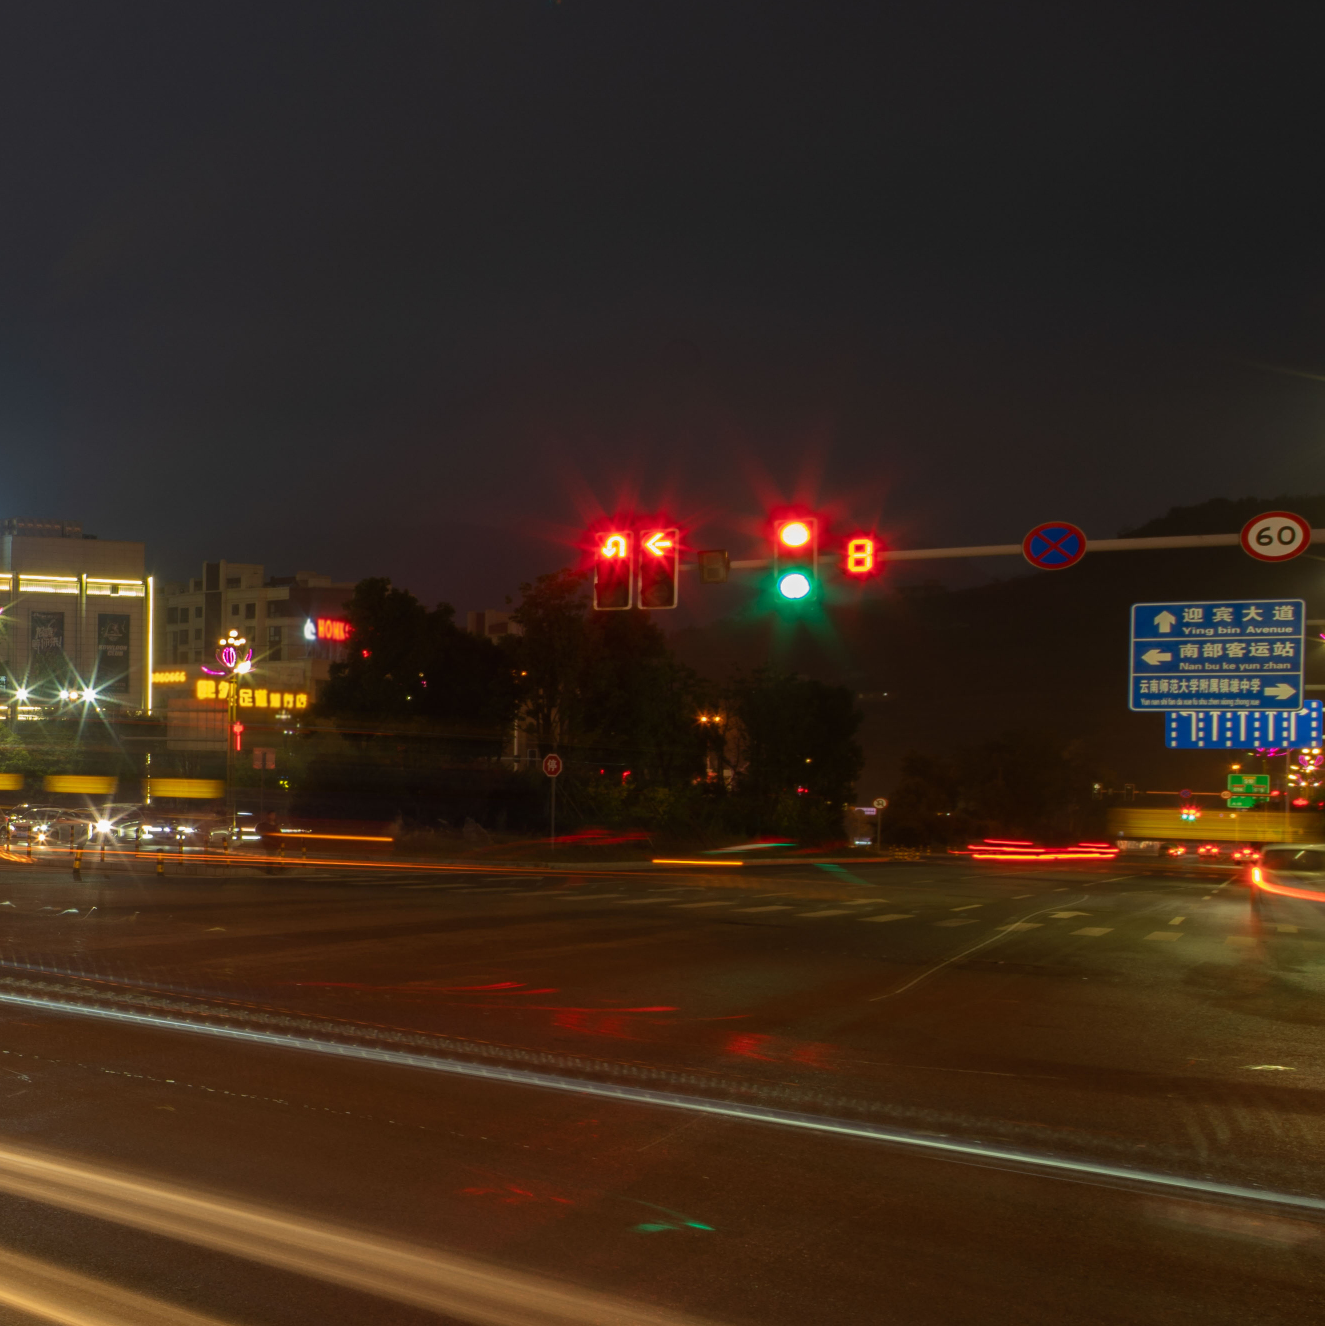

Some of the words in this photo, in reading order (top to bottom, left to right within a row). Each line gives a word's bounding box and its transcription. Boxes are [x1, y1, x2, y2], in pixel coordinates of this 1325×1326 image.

[1255, 525, 1296, 547] 60
[1182, 605, 1294, 623] 迎宾大道
[1182, 627, 1214, 636] Ying
[1217, 626, 1240, 634] bin
[1245, 625, 1293, 634] Avenue
[1179, 642, 1295, 659] 南部客运站
[1179, 662, 1202, 670] Nan
[1205, 661, 1219, 670] bu
[1223, 661, 1236, 670] ke
[1239, 663, 1260, 671] yun
